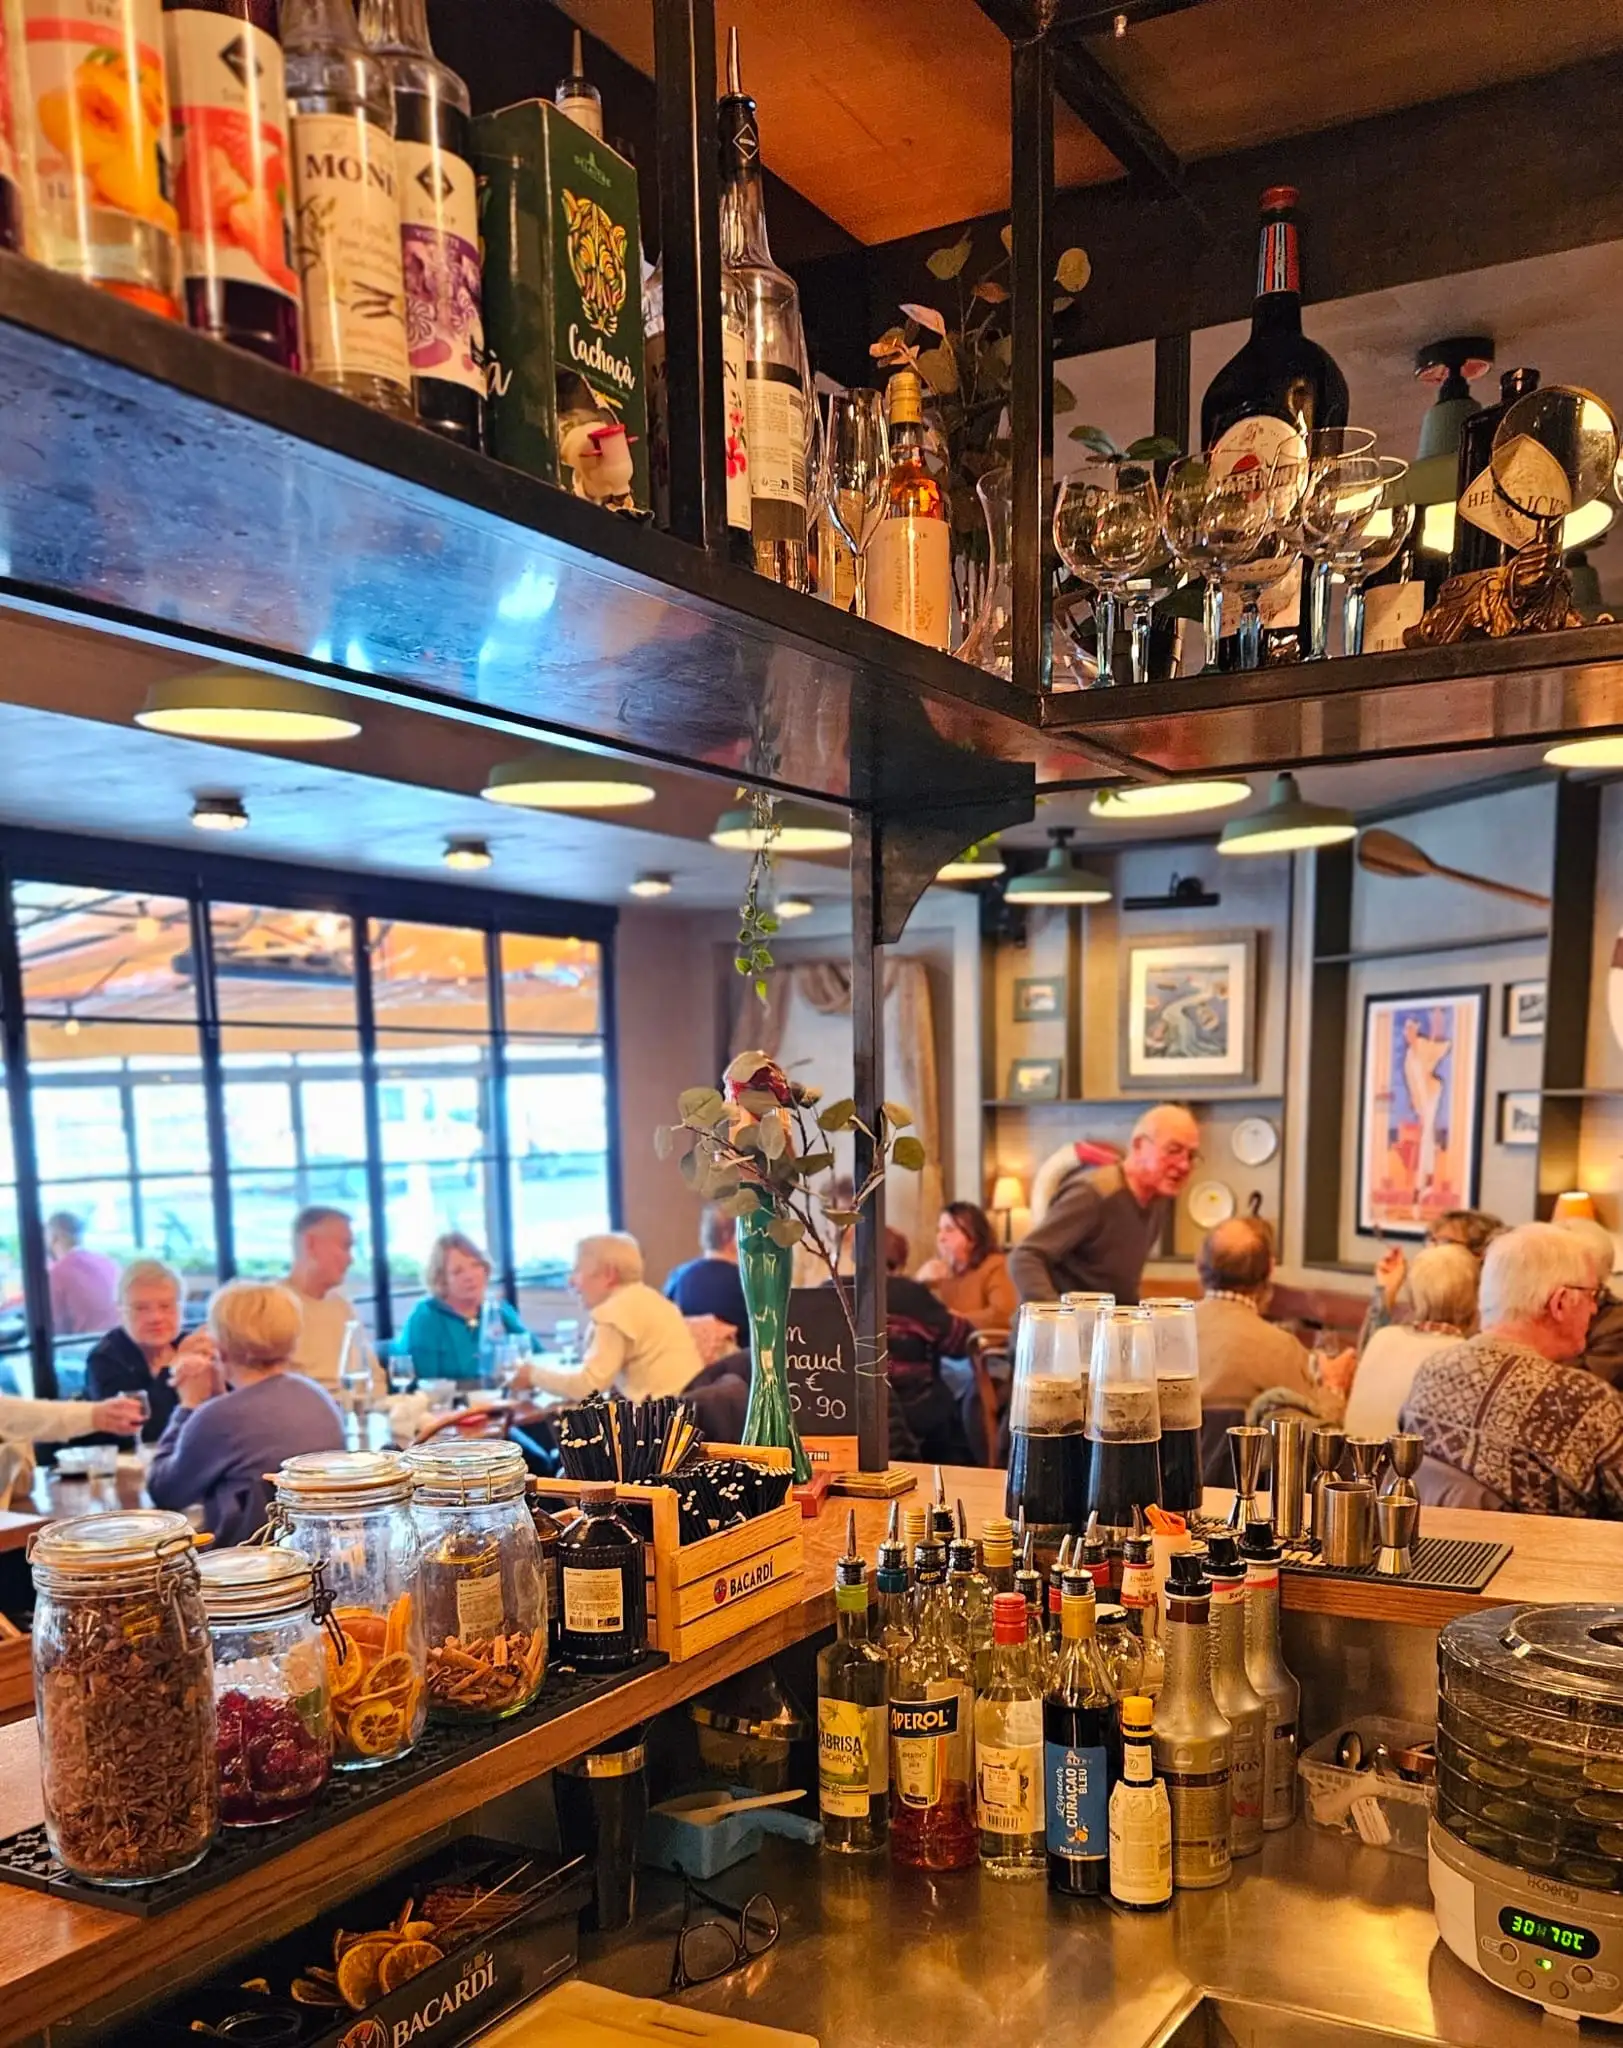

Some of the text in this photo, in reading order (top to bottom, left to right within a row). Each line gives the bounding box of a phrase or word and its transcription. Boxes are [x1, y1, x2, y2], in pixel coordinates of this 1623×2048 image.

[306, 153, 393, 197] MONI
[807, 1451, 829, 1460] TINI
[730, 1554, 774, 1597] BACARDÍ
[891, 1708, 949, 1731] APEROL
[1065, 1767, 1079, 1828] CURAÇAO
[1078, 1768, 1088, 1794] BLEU
[392, 1953, 495, 2048] BACARDÍ
